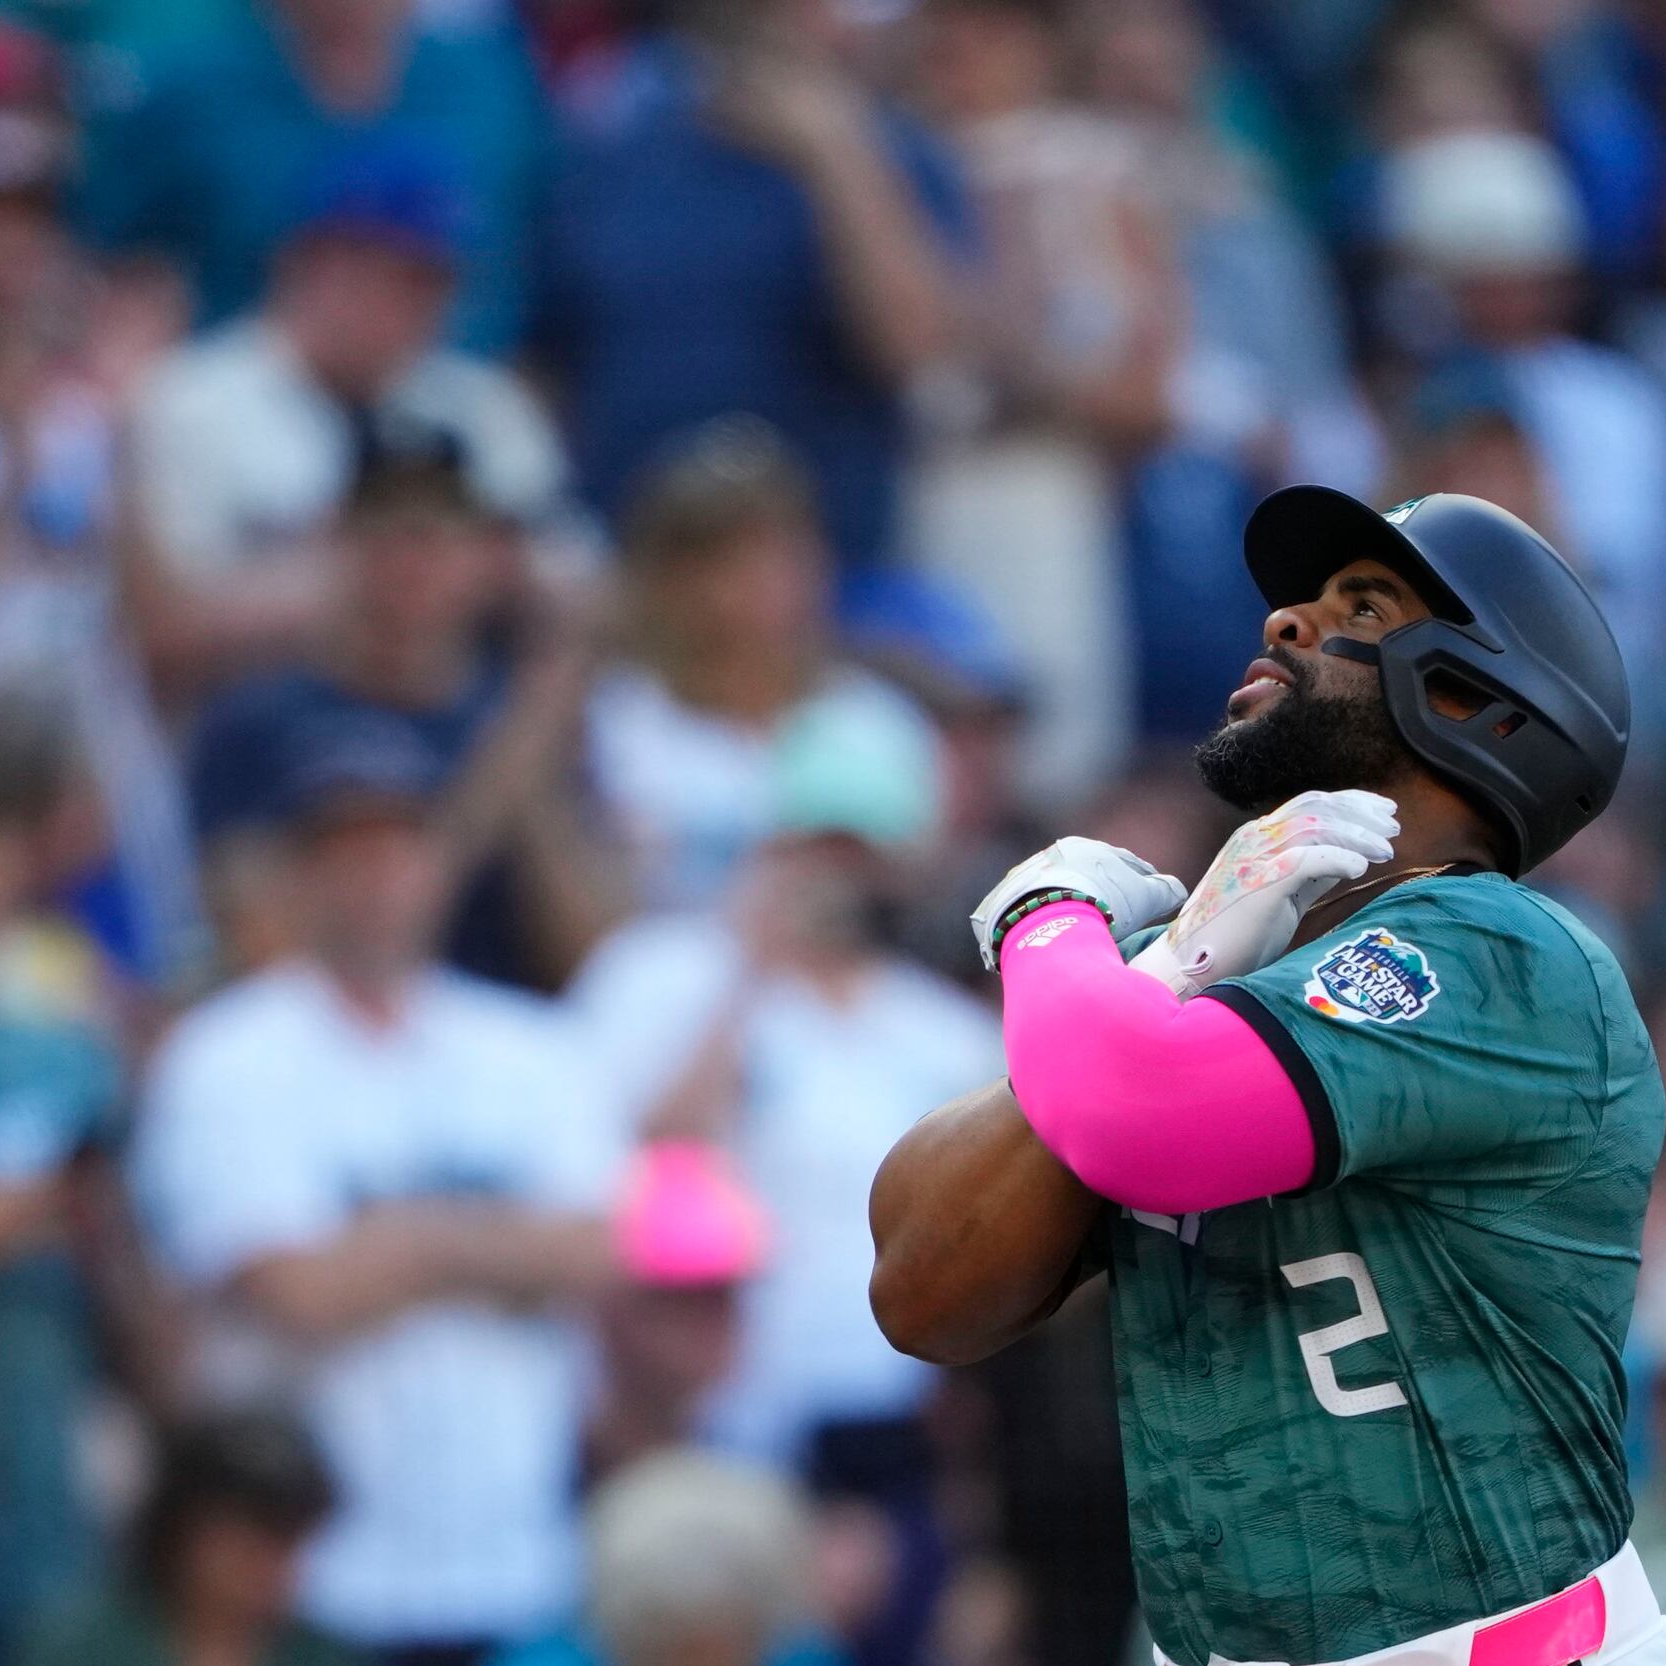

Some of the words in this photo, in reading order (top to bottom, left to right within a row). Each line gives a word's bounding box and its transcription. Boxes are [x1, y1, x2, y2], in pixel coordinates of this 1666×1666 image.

[1017, 916, 1079, 951] adidas
[1335, 948, 1373, 972] ALL
[1373, 967, 1418, 1014] STAR
[1336, 963, 1392, 1006] GAME
[1280, 1252, 1409, 1418] 2
